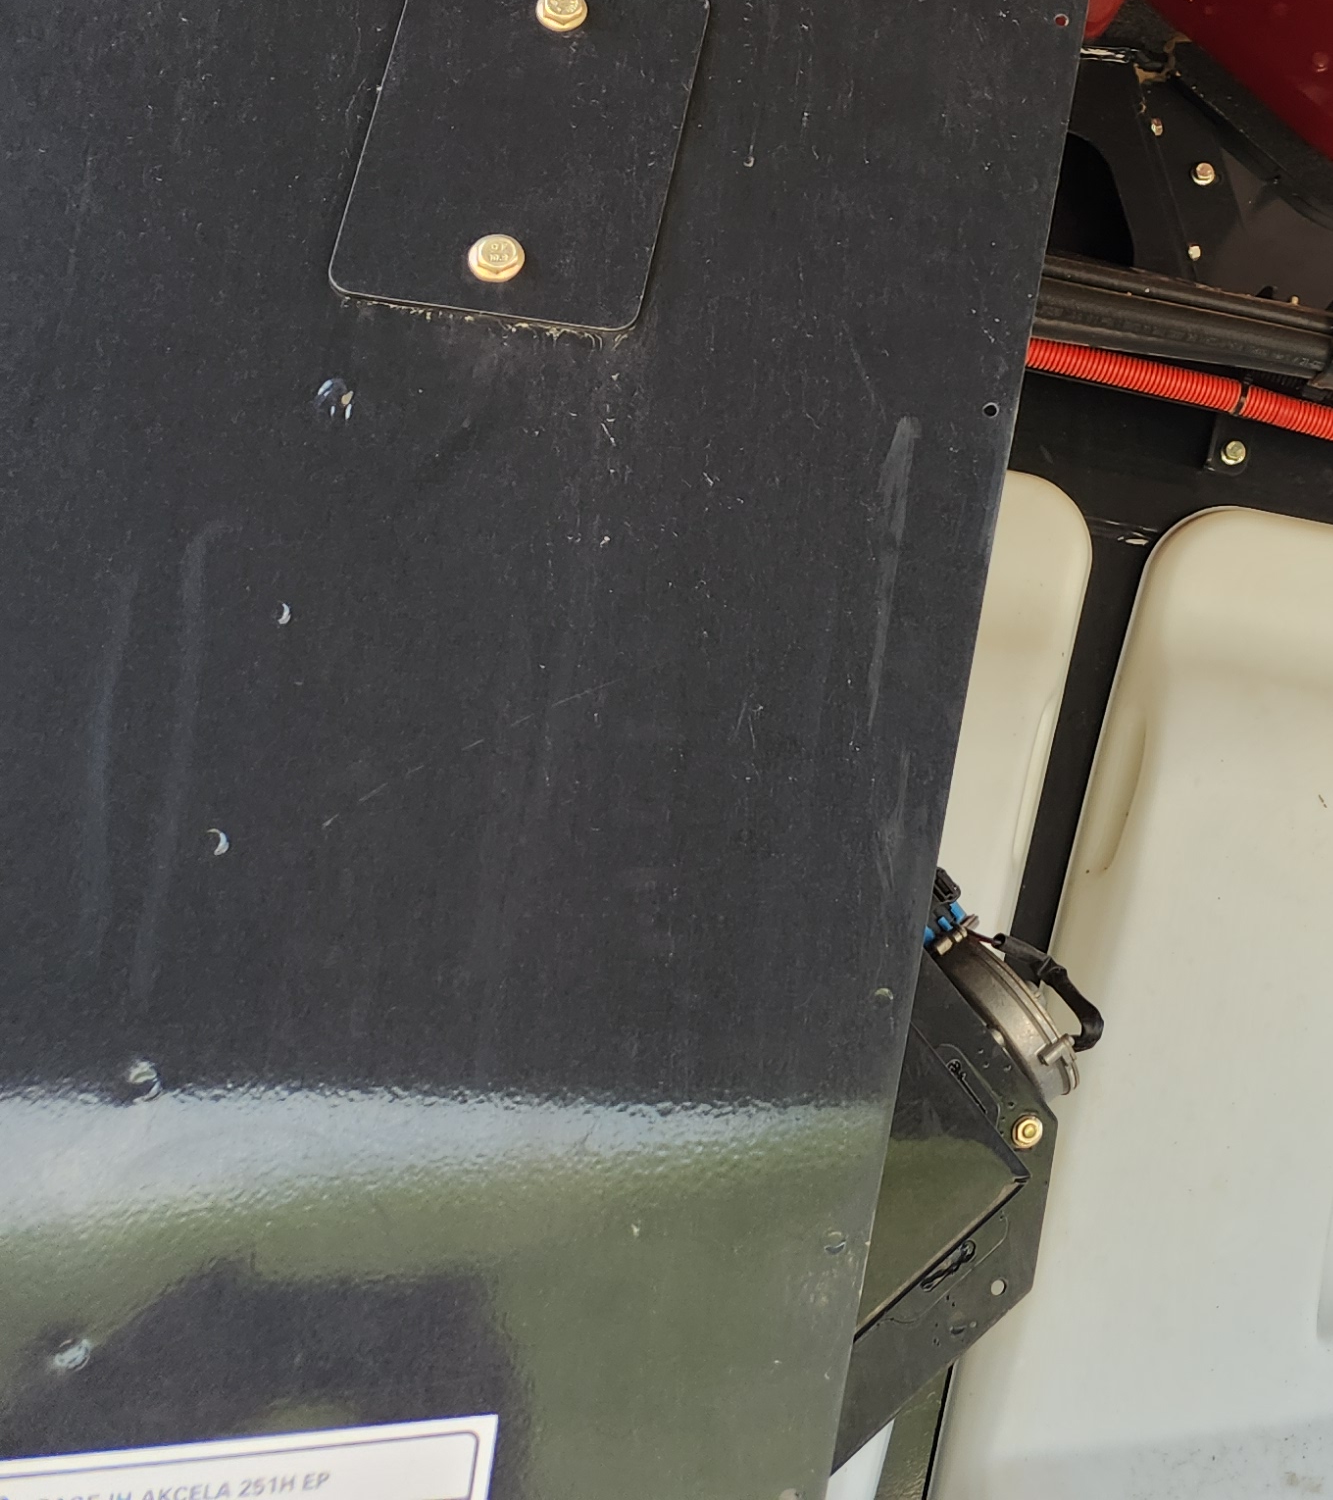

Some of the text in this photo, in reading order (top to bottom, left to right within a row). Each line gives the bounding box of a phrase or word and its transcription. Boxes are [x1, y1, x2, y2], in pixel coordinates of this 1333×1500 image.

[141, 1481, 231, 1500] AKCELA
[237, 1473, 297, 1498] 251H
[301, 1471, 331, 1492] EP
